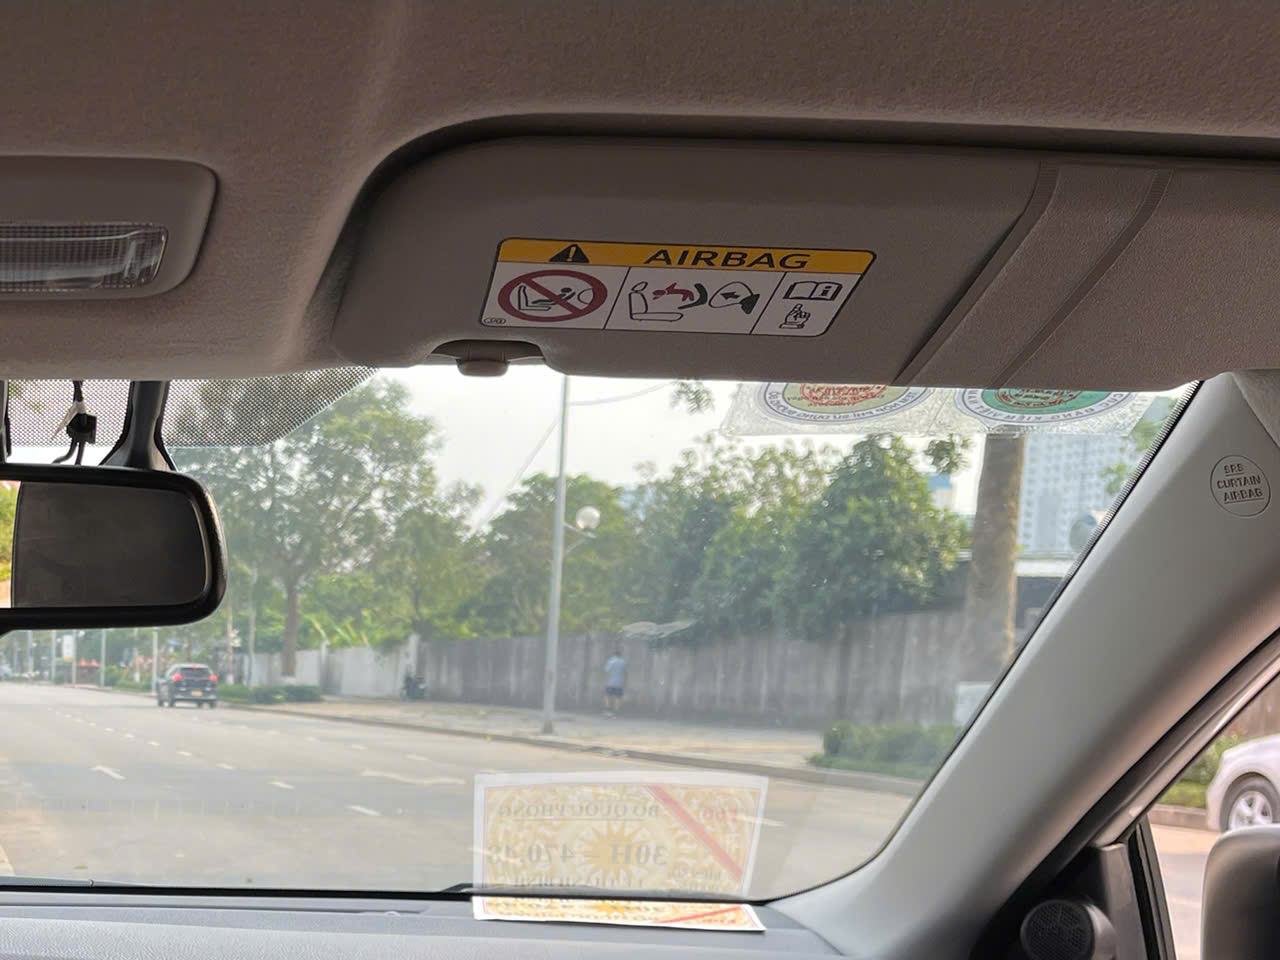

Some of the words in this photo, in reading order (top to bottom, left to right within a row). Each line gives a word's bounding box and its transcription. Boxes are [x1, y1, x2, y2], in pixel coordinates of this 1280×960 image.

[645, 249, 811, 269] AIRBAG
[1217, 475, 1261, 489] CURTAIN
[1224, 488, 1263, 502] AIRBAG
